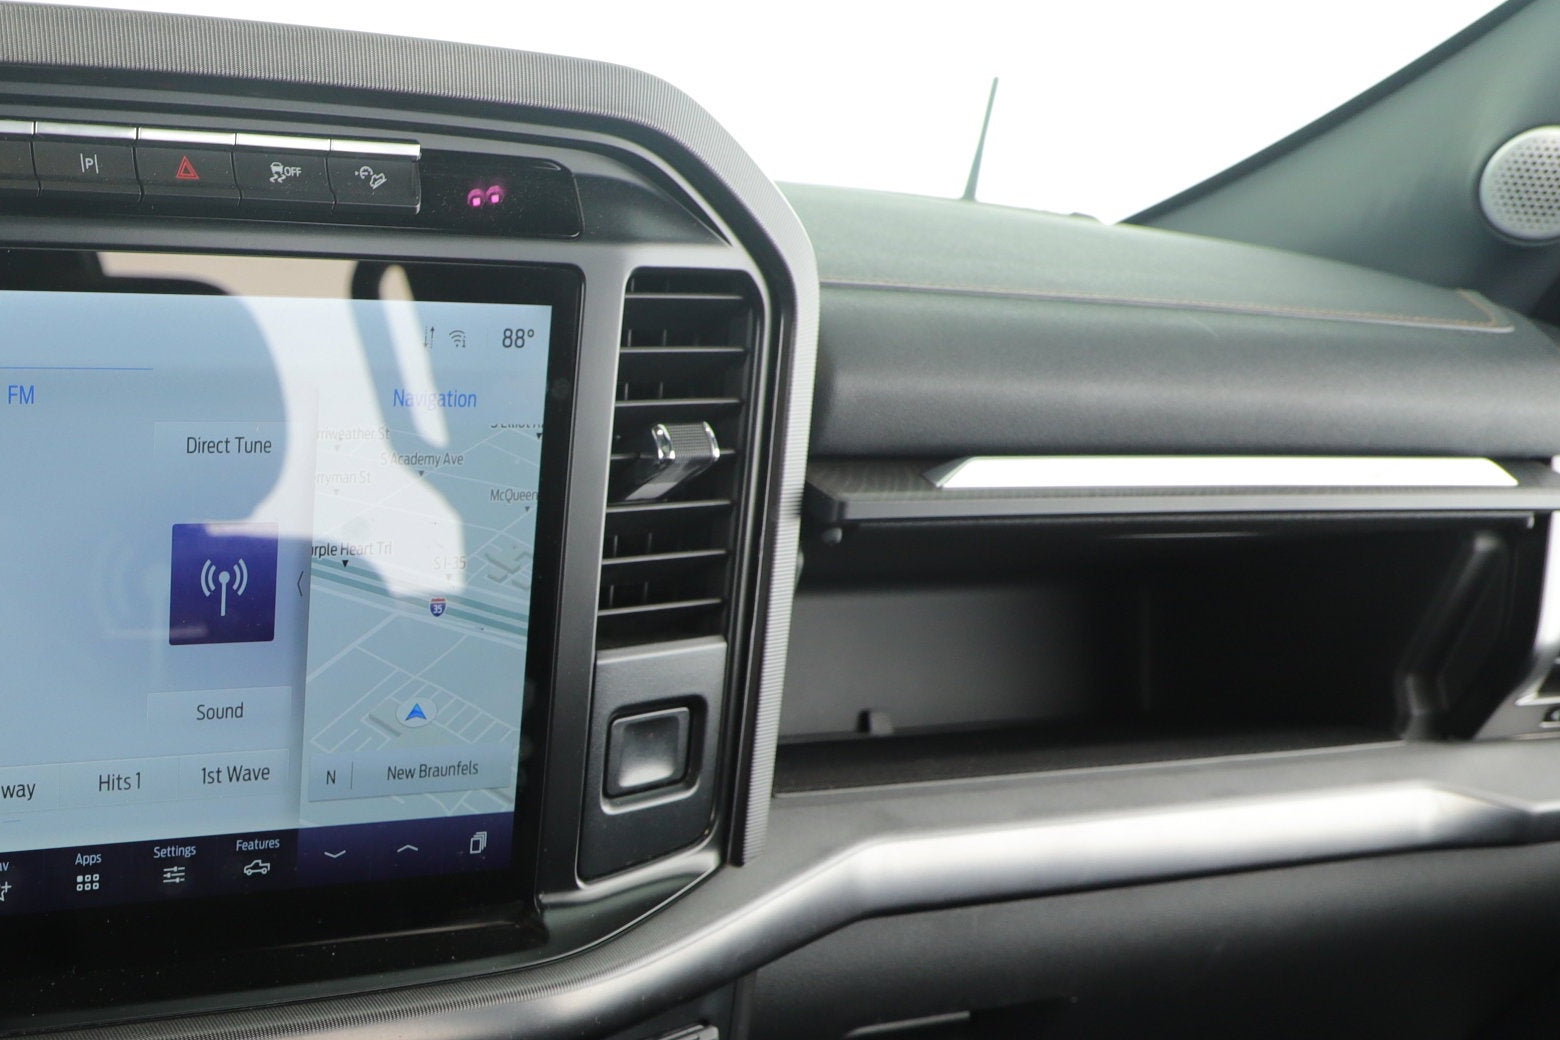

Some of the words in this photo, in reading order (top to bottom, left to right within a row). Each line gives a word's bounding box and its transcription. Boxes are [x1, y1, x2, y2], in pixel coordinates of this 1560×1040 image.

[283, 166, 303, 178] OFF
[501, 328, 535, 349] 88°
[7, 385, 35, 405] FM
[393, 389, 477, 410] Navigation
[186, 437, 230, 454] Direct
[234, 436, 272, 454] Tune
[389, 451, 440, 469] Academy
[442, 451, 464, 466] Ave
[340, 542, 373, 557] Heart
[432, 604, 443, 614] 35
[196, 702, 244, 721] Sound
[201, 767, 224, 786] 1st
[227, 765, 270, 784] Wave
[325, 769, 337, 785] N
[387, 765, 416, 781] New
[419, 760, 479, 779] Braunfels
[98, 773, 132, 792] Hits
[153, 843, 197, 861] Settings
[236, 836, 280, 852] Features
[75, 852, 102, 867] Apps
